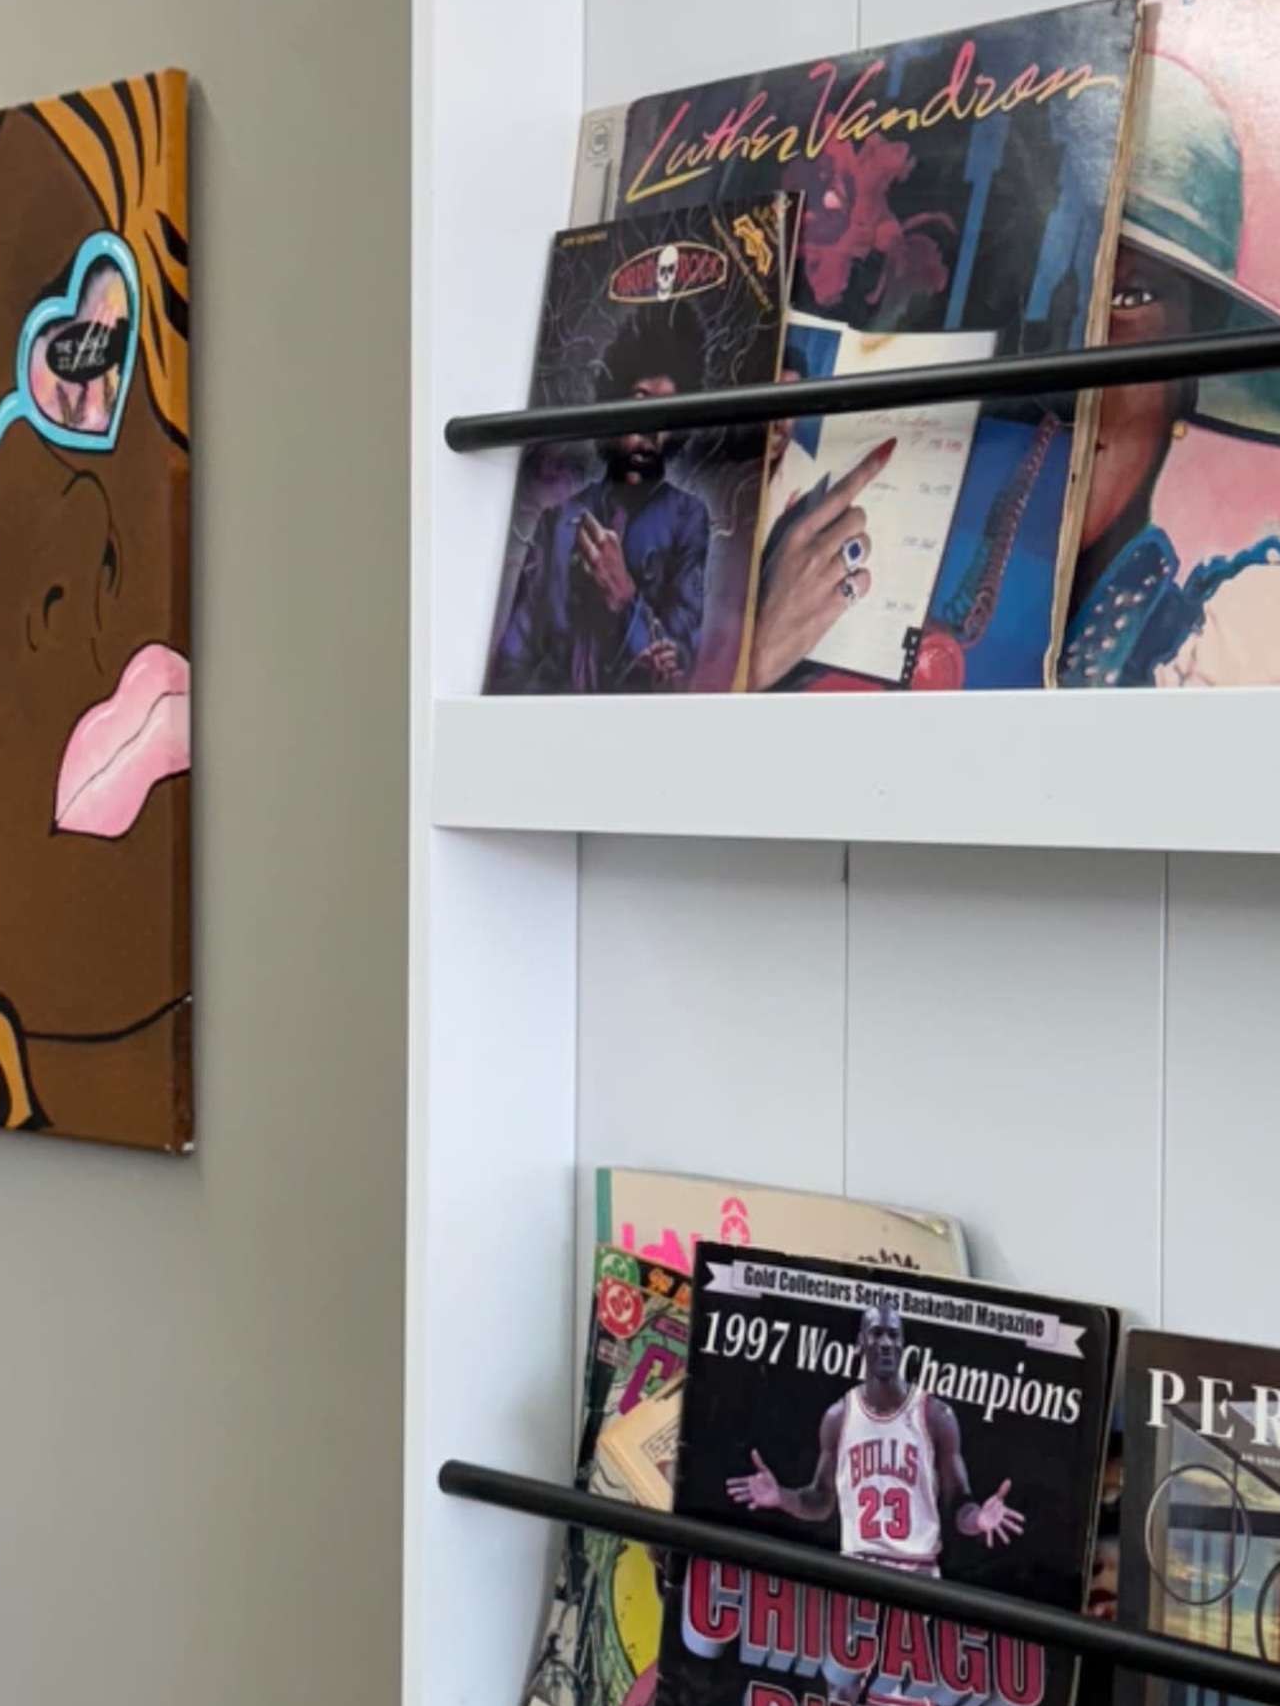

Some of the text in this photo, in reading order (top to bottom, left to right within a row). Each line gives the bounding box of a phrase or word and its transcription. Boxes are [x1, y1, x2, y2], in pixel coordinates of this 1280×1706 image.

[625, 91, 800, 204] Luther
[806, 41, 1119, 159] Vandross
[743, 1265, 1045, 1337] Gold Collectors Series Basketball Magazine
[700, 1309, 791, 1364] 1997
[899, 1344, 1082, 1425] Champions
[850, 1439, 918, 1489] BULLS
[857, 1487, 912, 1541] 23
